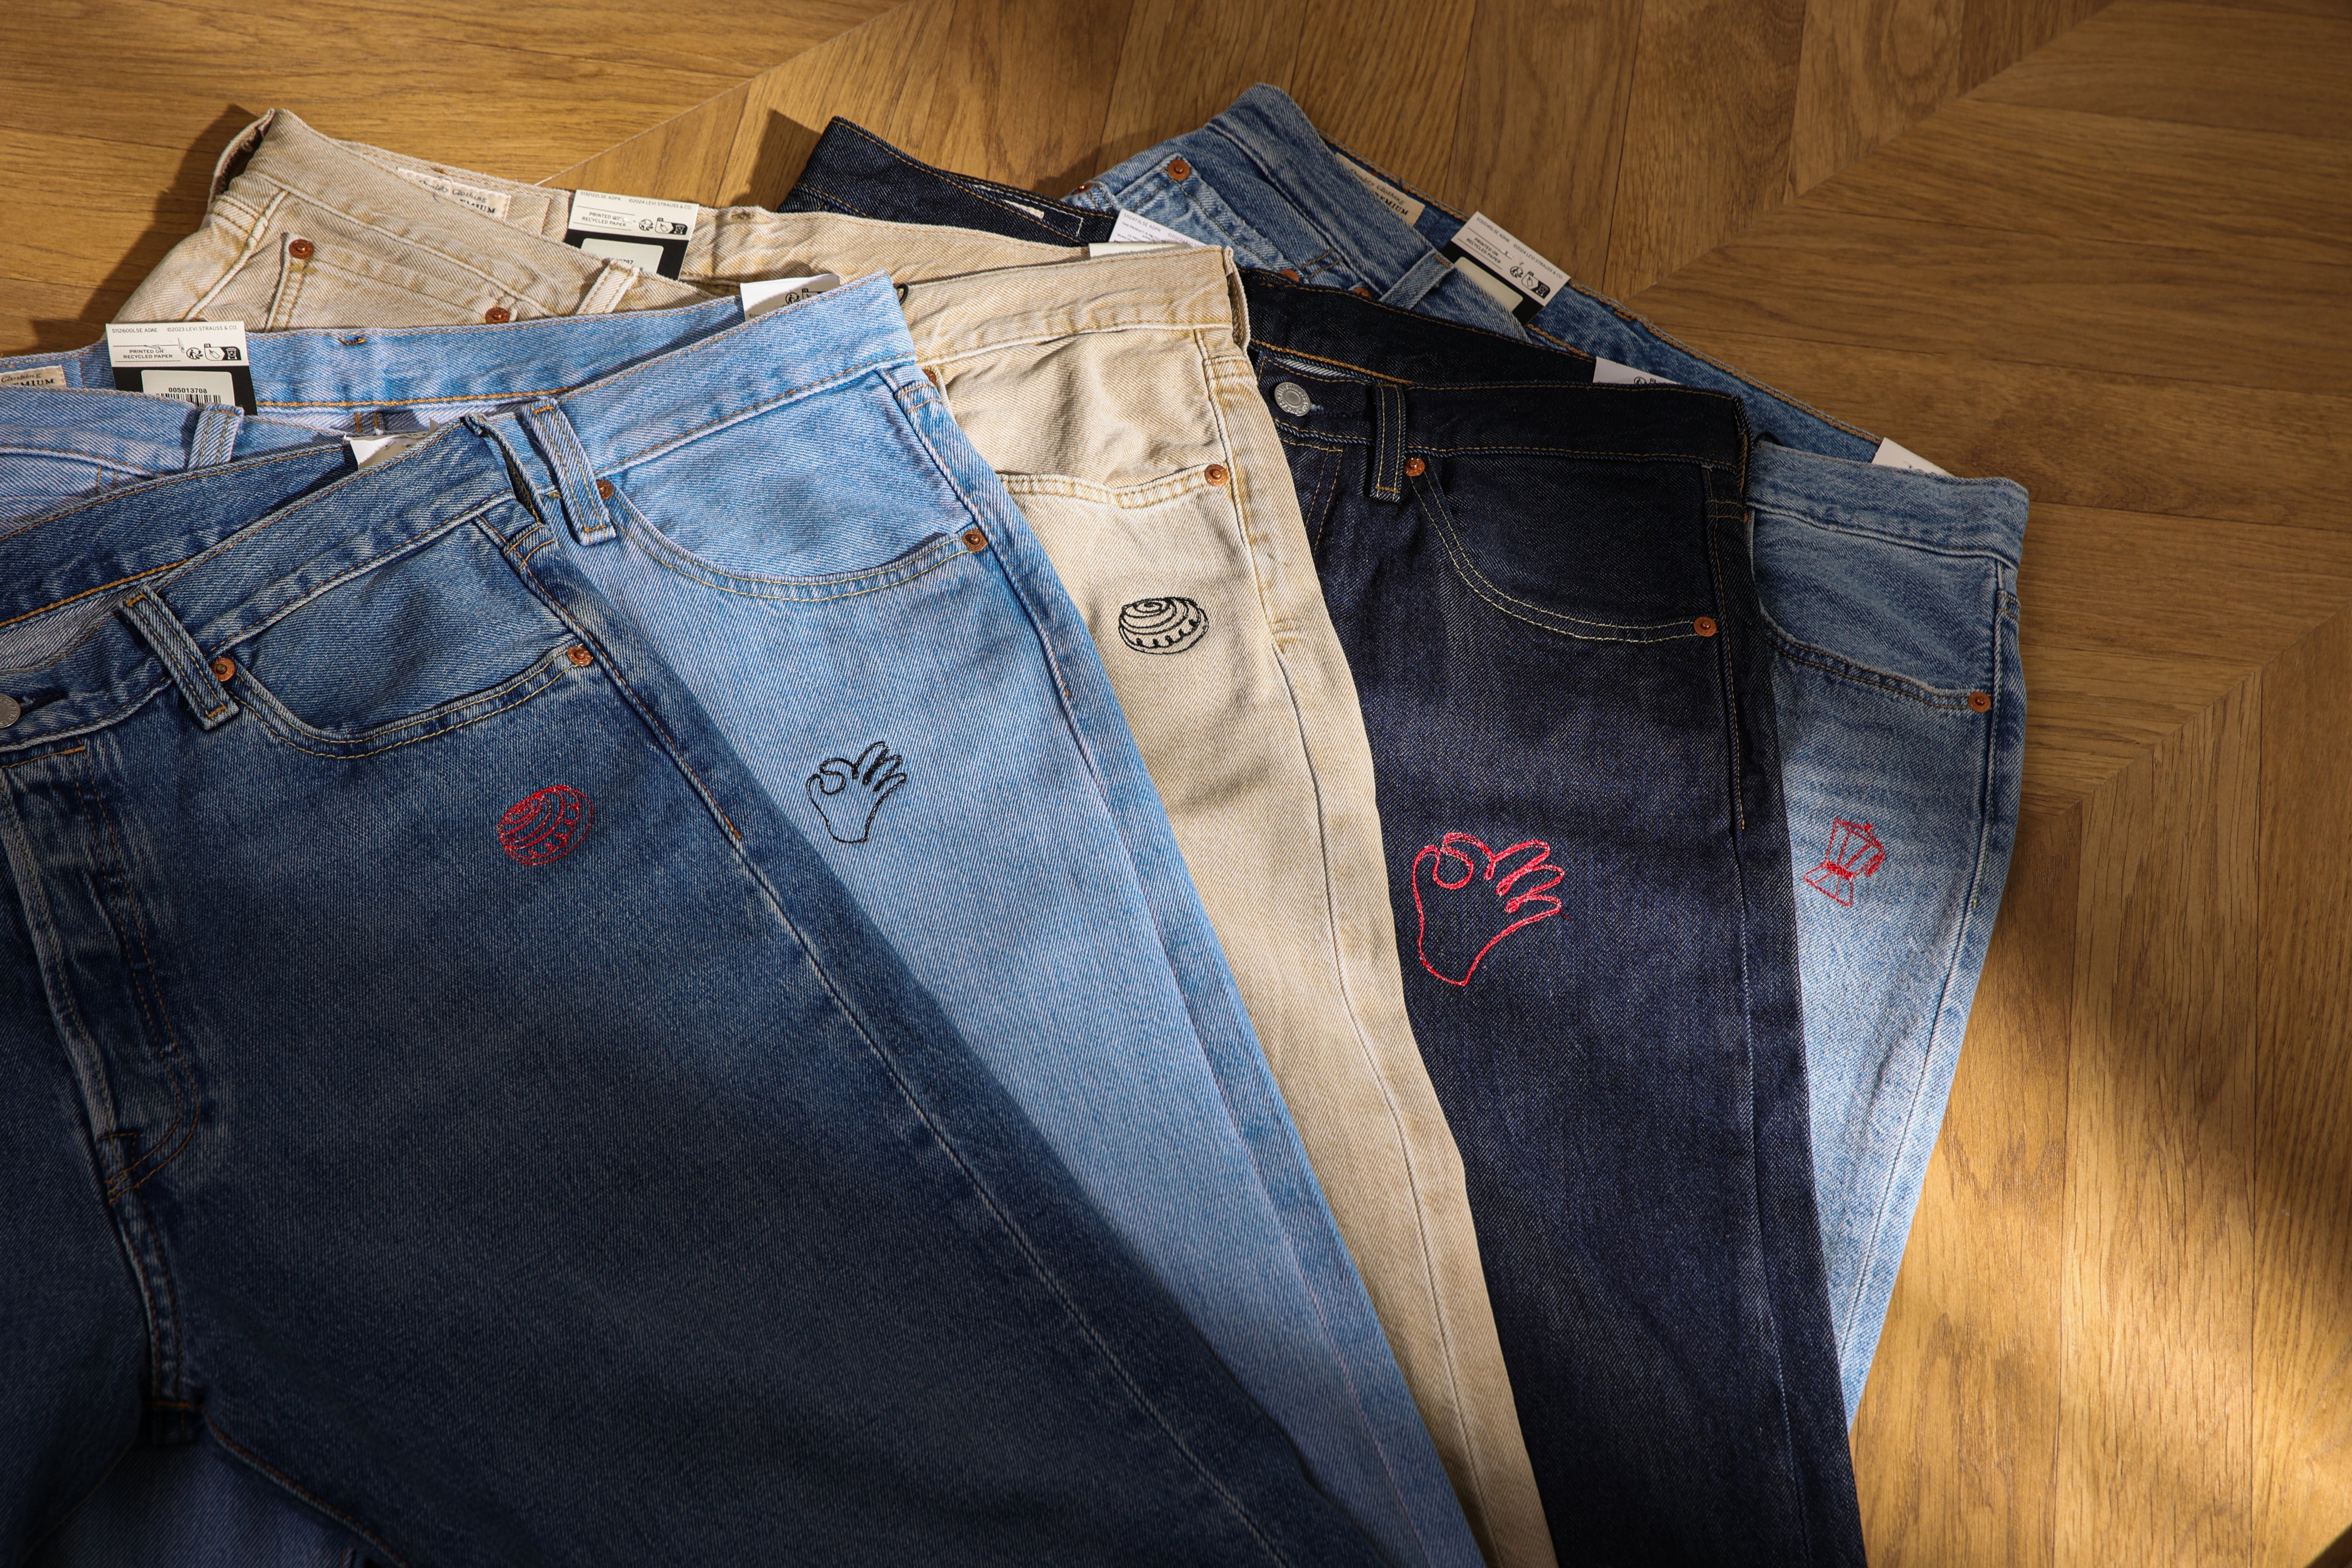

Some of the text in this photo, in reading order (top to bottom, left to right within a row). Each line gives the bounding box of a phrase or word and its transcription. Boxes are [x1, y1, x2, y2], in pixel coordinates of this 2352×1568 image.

[452, 189, 487, 203] Clothing
[1377, 185, 1405, 205] Clothing
[1466, 238, 1501, 263] RECYCLED PAPER
[1474, 237, 1492, 251] PRINTED
[1526, 252, 1535, 260] LEVI
[1535, 258, 1553, 272] STRAUSS
[1, 373, 41, 383] Clothing
